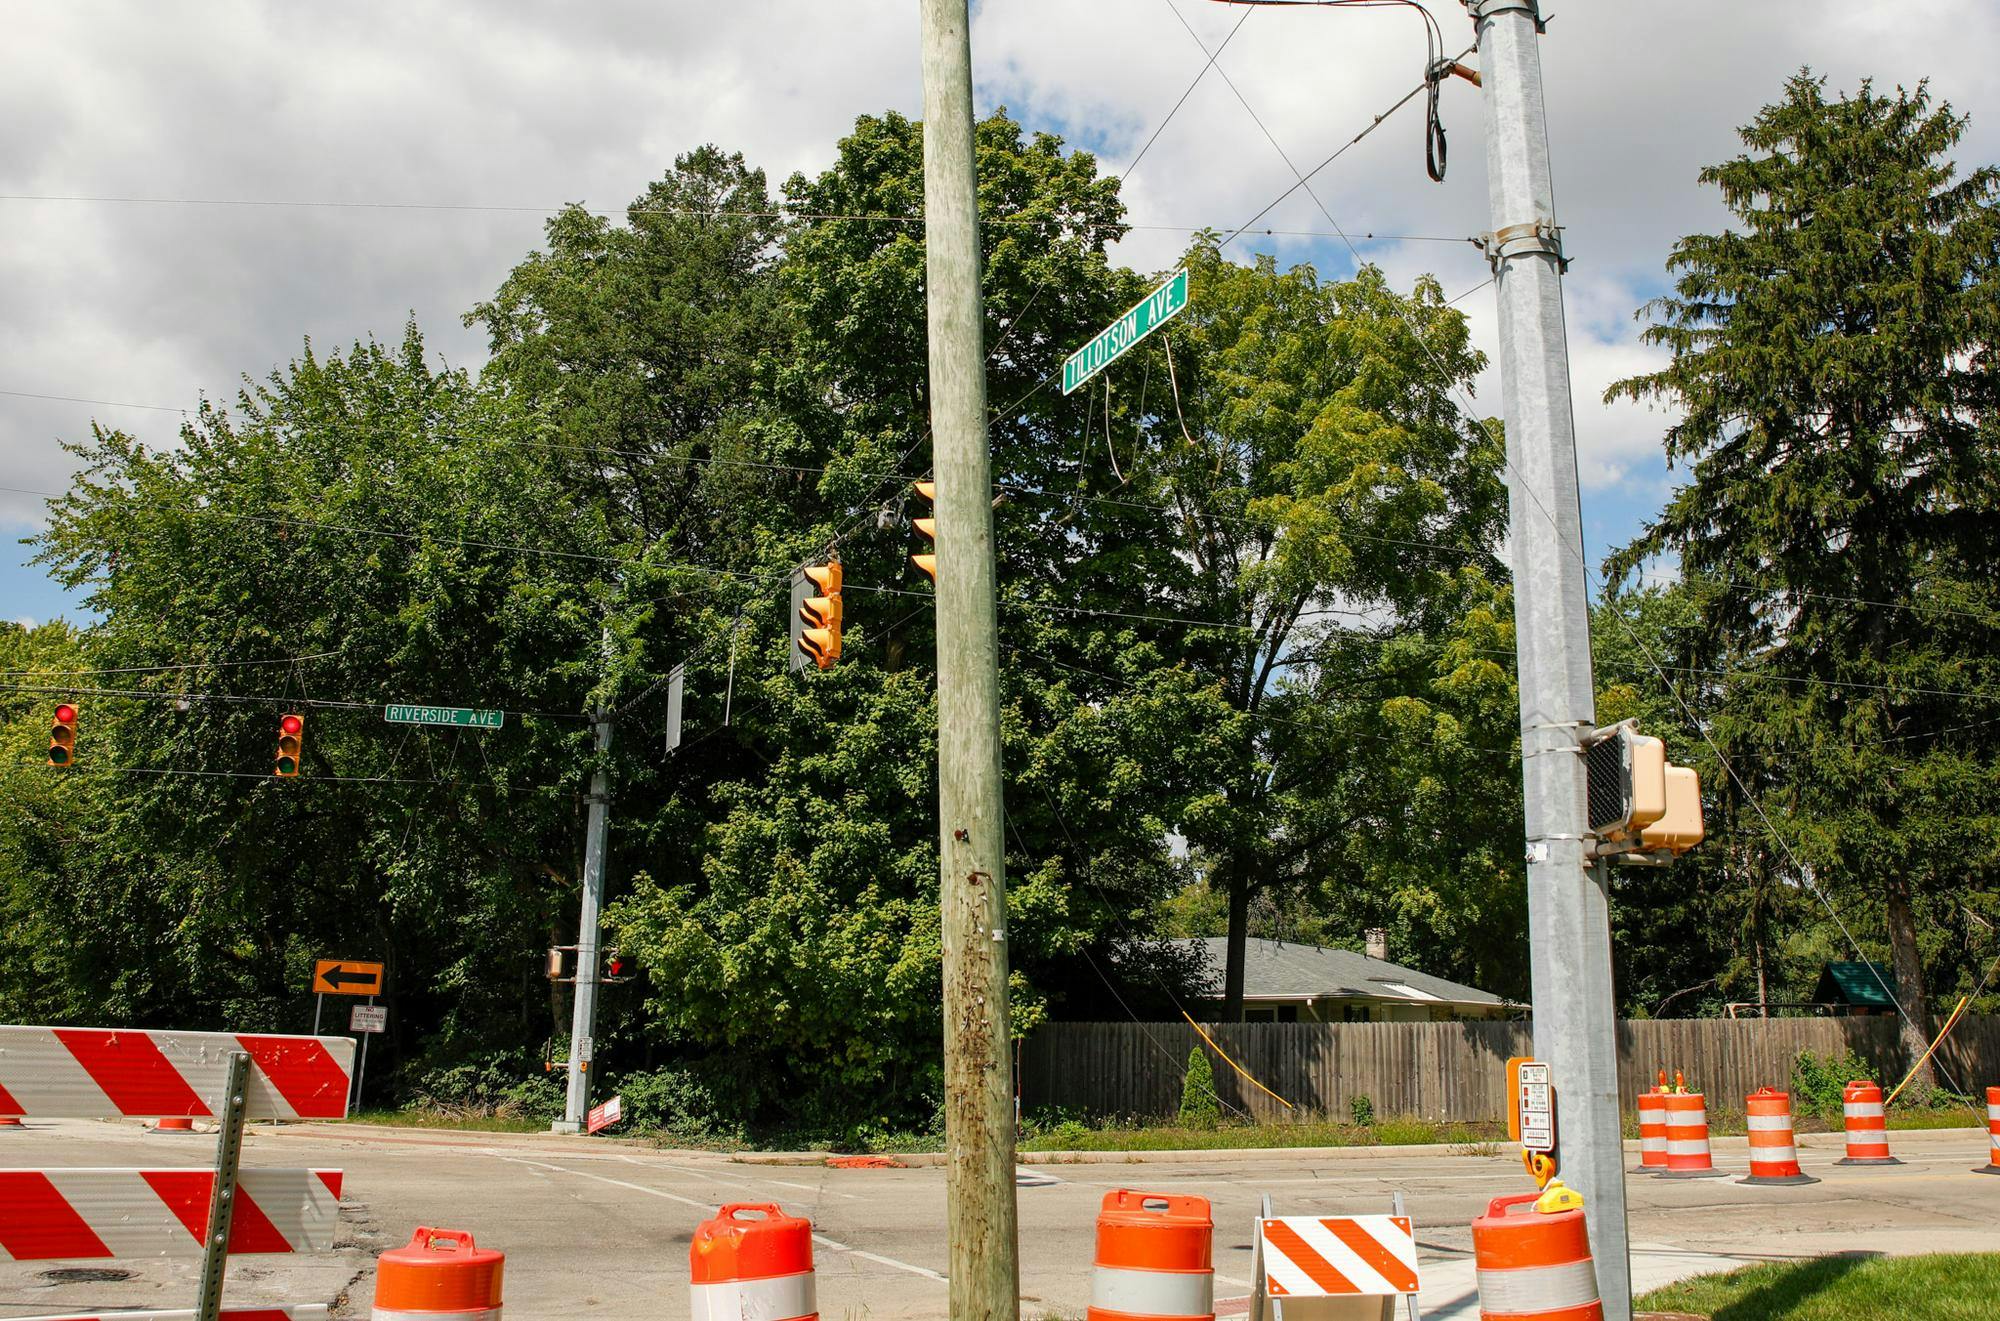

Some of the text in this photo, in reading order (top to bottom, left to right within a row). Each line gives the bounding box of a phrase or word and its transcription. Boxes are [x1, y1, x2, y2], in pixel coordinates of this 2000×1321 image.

[1070, 283, 1180, 385] TILLOTSON AVE.
[390, 707, 499, 726] RIVERSIDE AVE.
